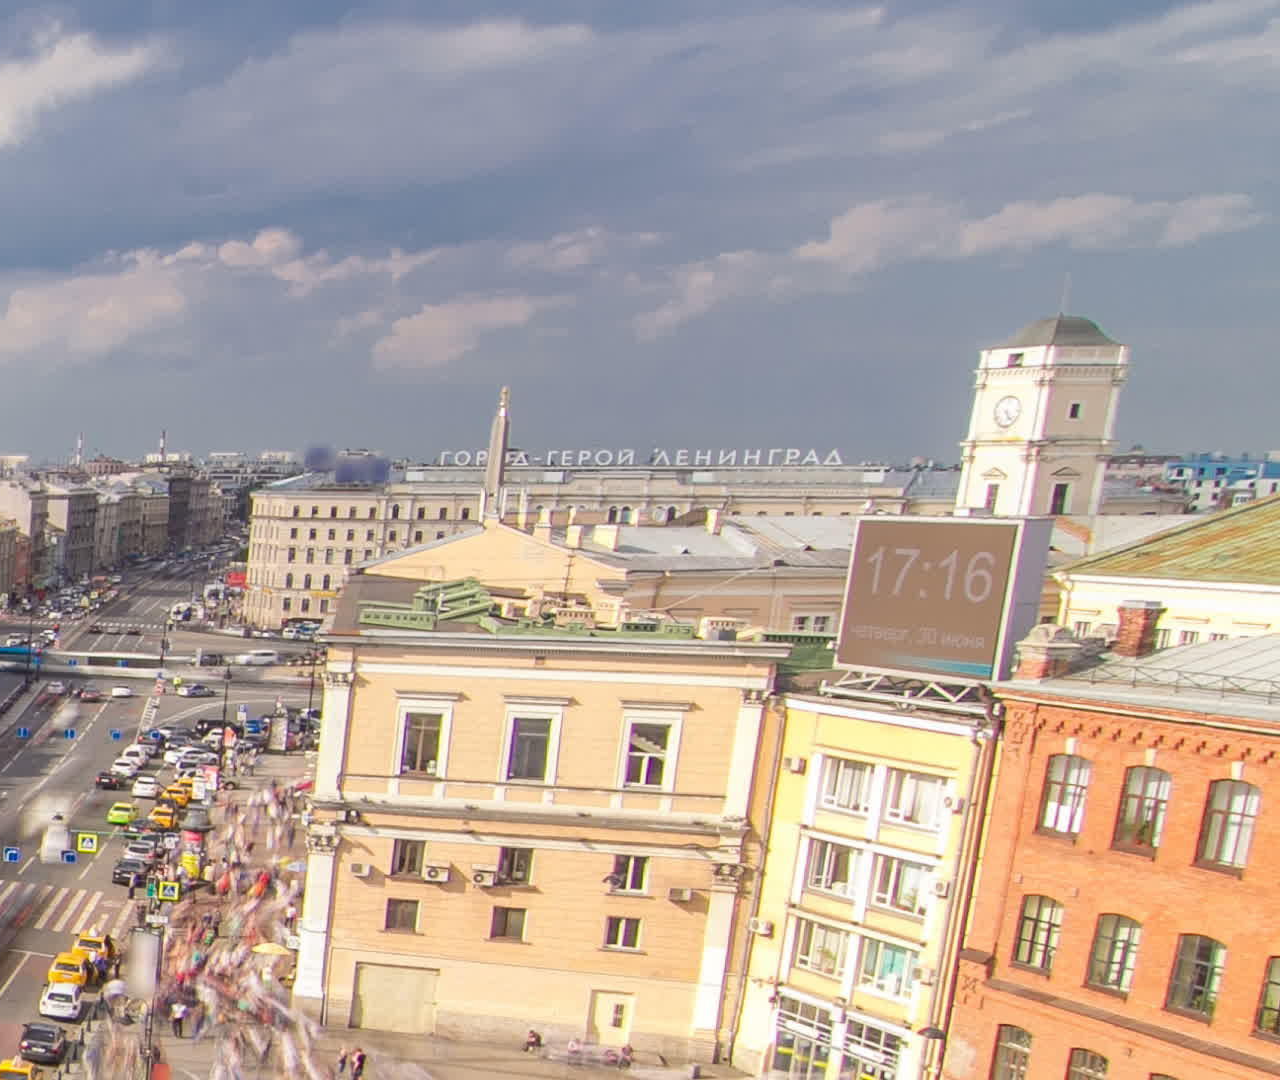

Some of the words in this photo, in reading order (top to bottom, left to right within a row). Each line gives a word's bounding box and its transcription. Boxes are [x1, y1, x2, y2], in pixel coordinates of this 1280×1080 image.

[440, 448, 635, 466] ГОРД-ГЕРОЙ
[654, 447, 843, 466] ЛЕНИНГРАД
[866, 546, 996, 603] 17:16
